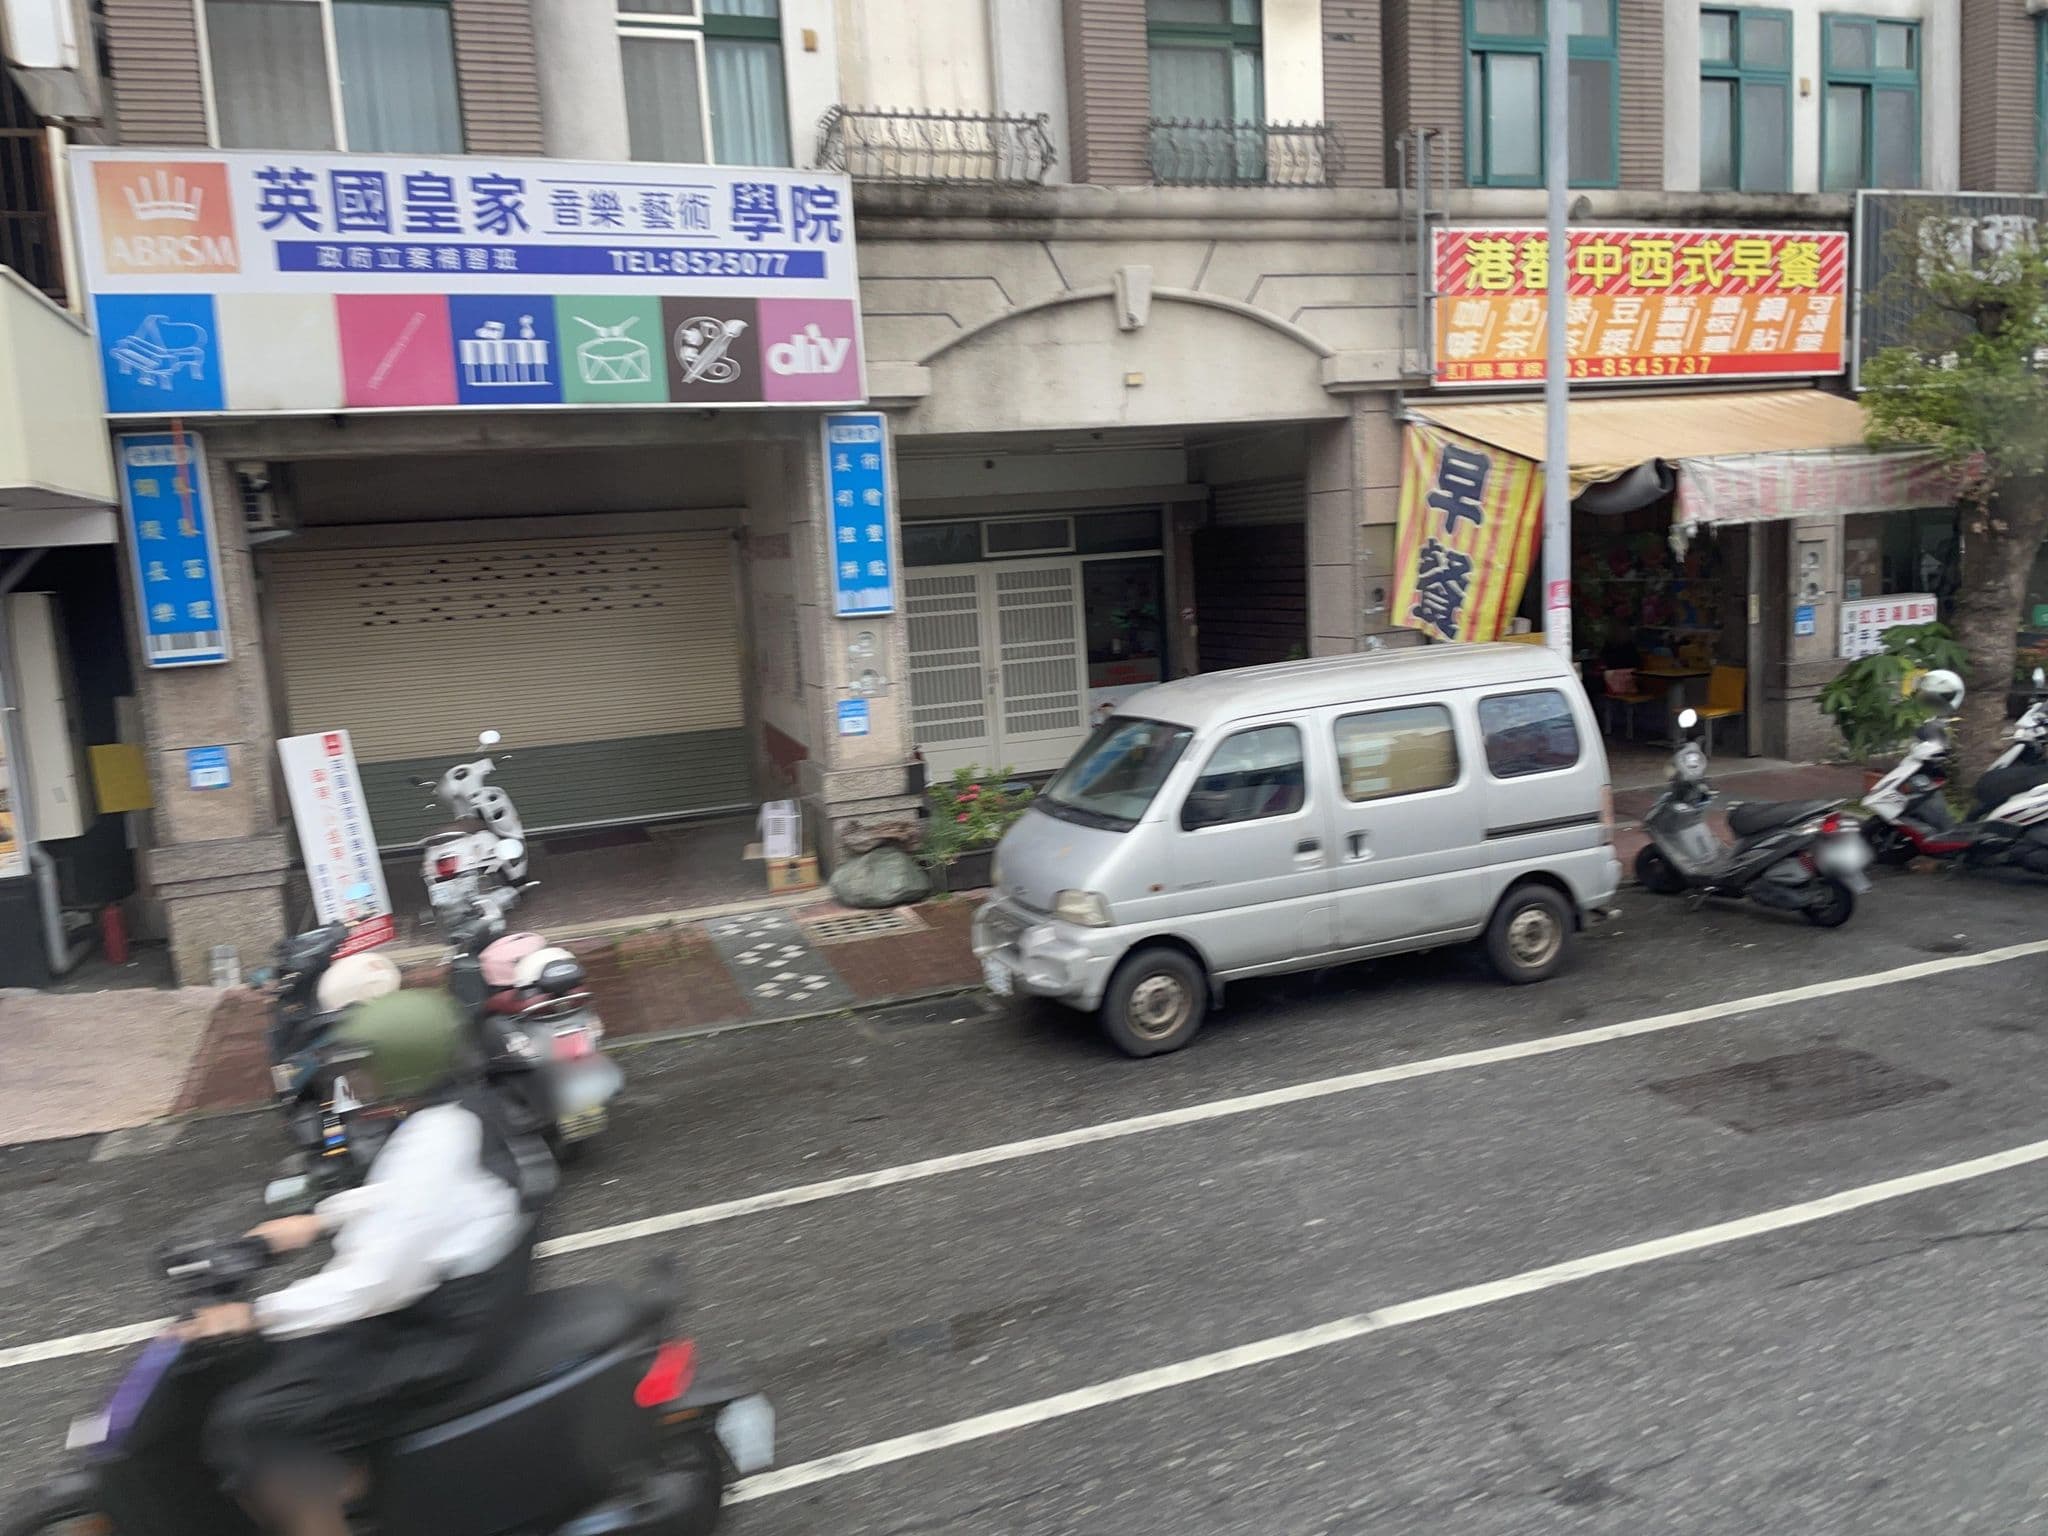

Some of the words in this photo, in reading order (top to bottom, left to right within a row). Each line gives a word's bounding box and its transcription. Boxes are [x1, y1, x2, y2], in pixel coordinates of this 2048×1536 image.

[252, 165, 530, 236] 英國皇家
[730, 181, 843, 244] 學院
[111, 235, 238, 267] ABRSM
[316, 245, 519, 272] 政府立案補習班
[609, 249, 789, 276] TEL:8525077
[767, 323, 852, 376] diy
[1412, 443, 1491, 640] 早餐
